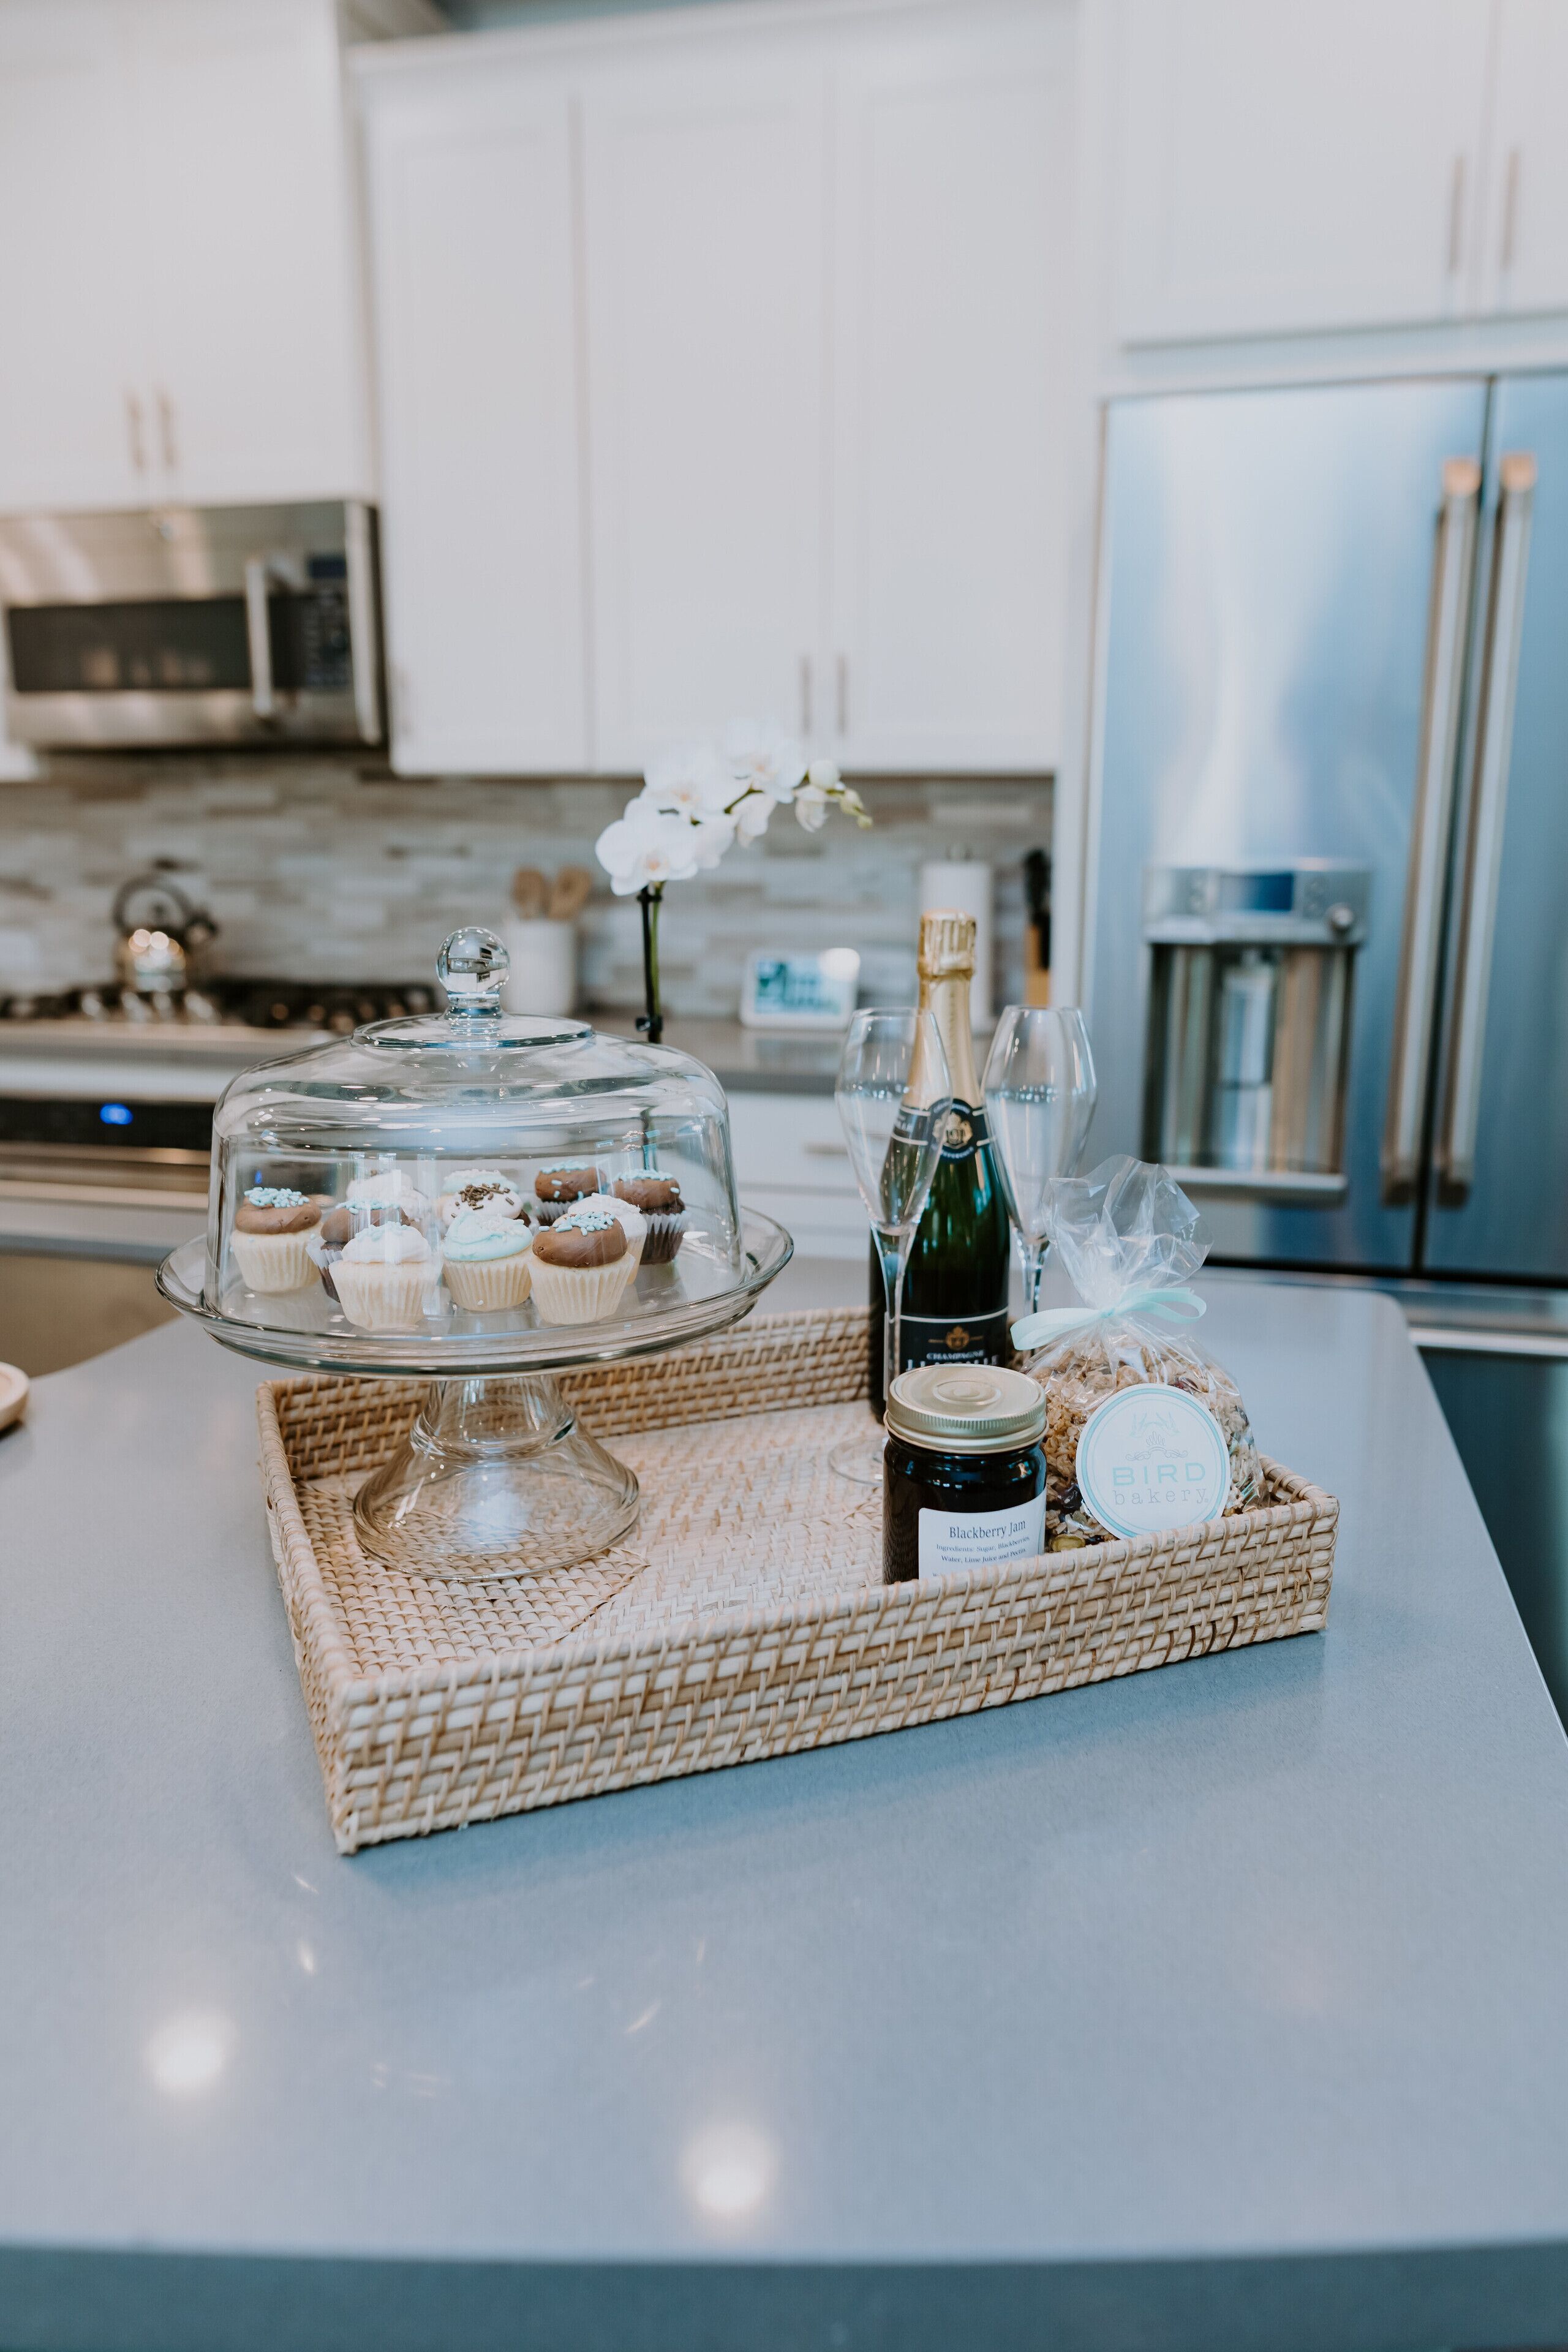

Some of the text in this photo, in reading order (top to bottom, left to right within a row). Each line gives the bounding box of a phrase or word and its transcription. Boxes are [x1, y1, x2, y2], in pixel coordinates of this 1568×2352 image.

[926, 1349, 984, 1360] CHAMPAGNE
[1113, 1463, 1205, 1486] BIRD
[1113, 1488, 1207, 1505] bakery
[949, 1520, 1026, 1539] Blackberry Jam
